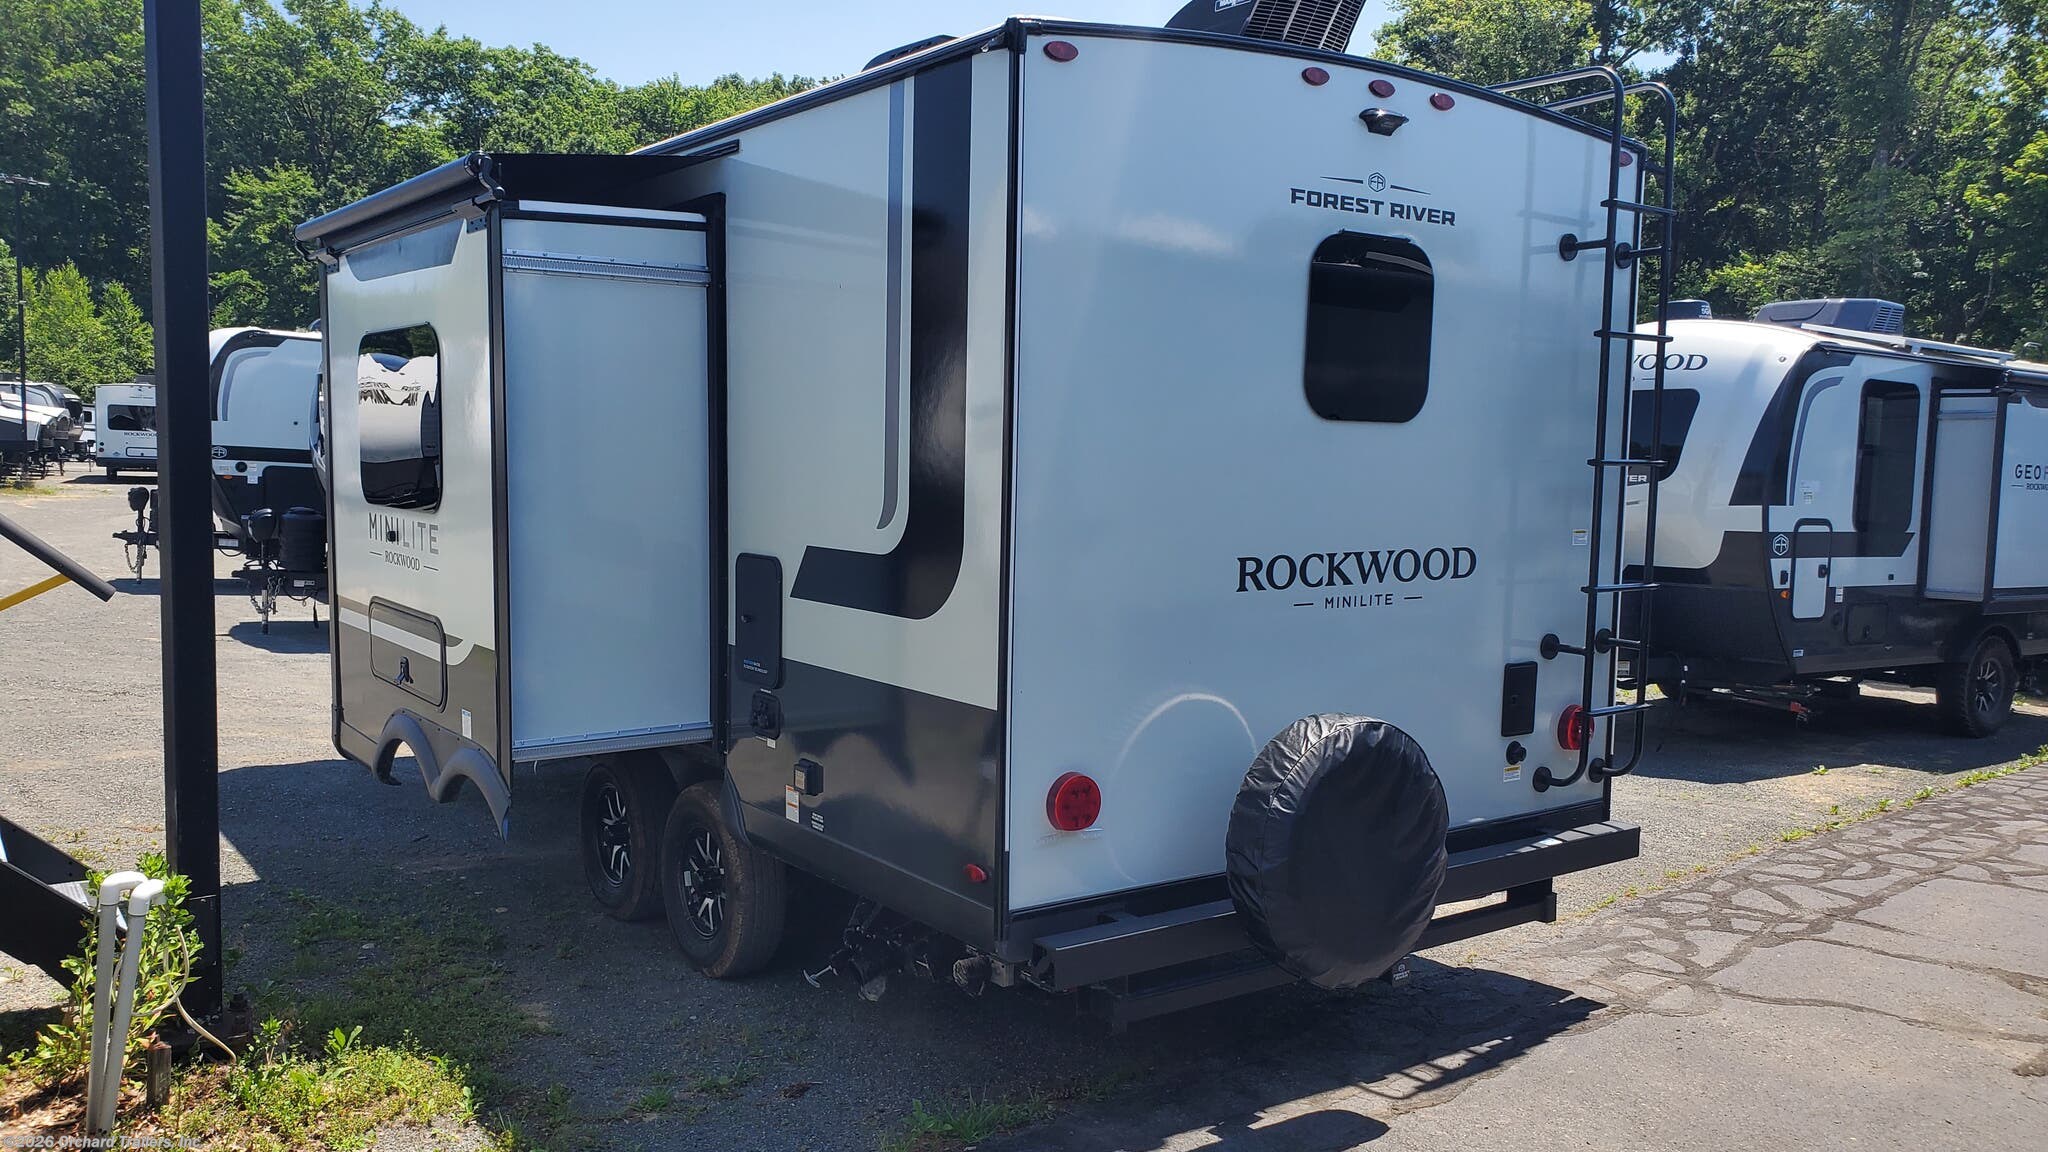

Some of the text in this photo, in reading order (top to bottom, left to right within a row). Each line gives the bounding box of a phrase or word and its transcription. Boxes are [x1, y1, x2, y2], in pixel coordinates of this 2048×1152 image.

[1290, 187, 1456, 226] FOREST RIVER
[1633, 353, 1708, 371] OOD
[368, 512, 440, 555] MINILITE
[384, 550, 421, 571] ROCKWOOD
[1236, 547, 1477, 592] ROCKWOOD
[1324, 593, 1394, 610] MINILITE
